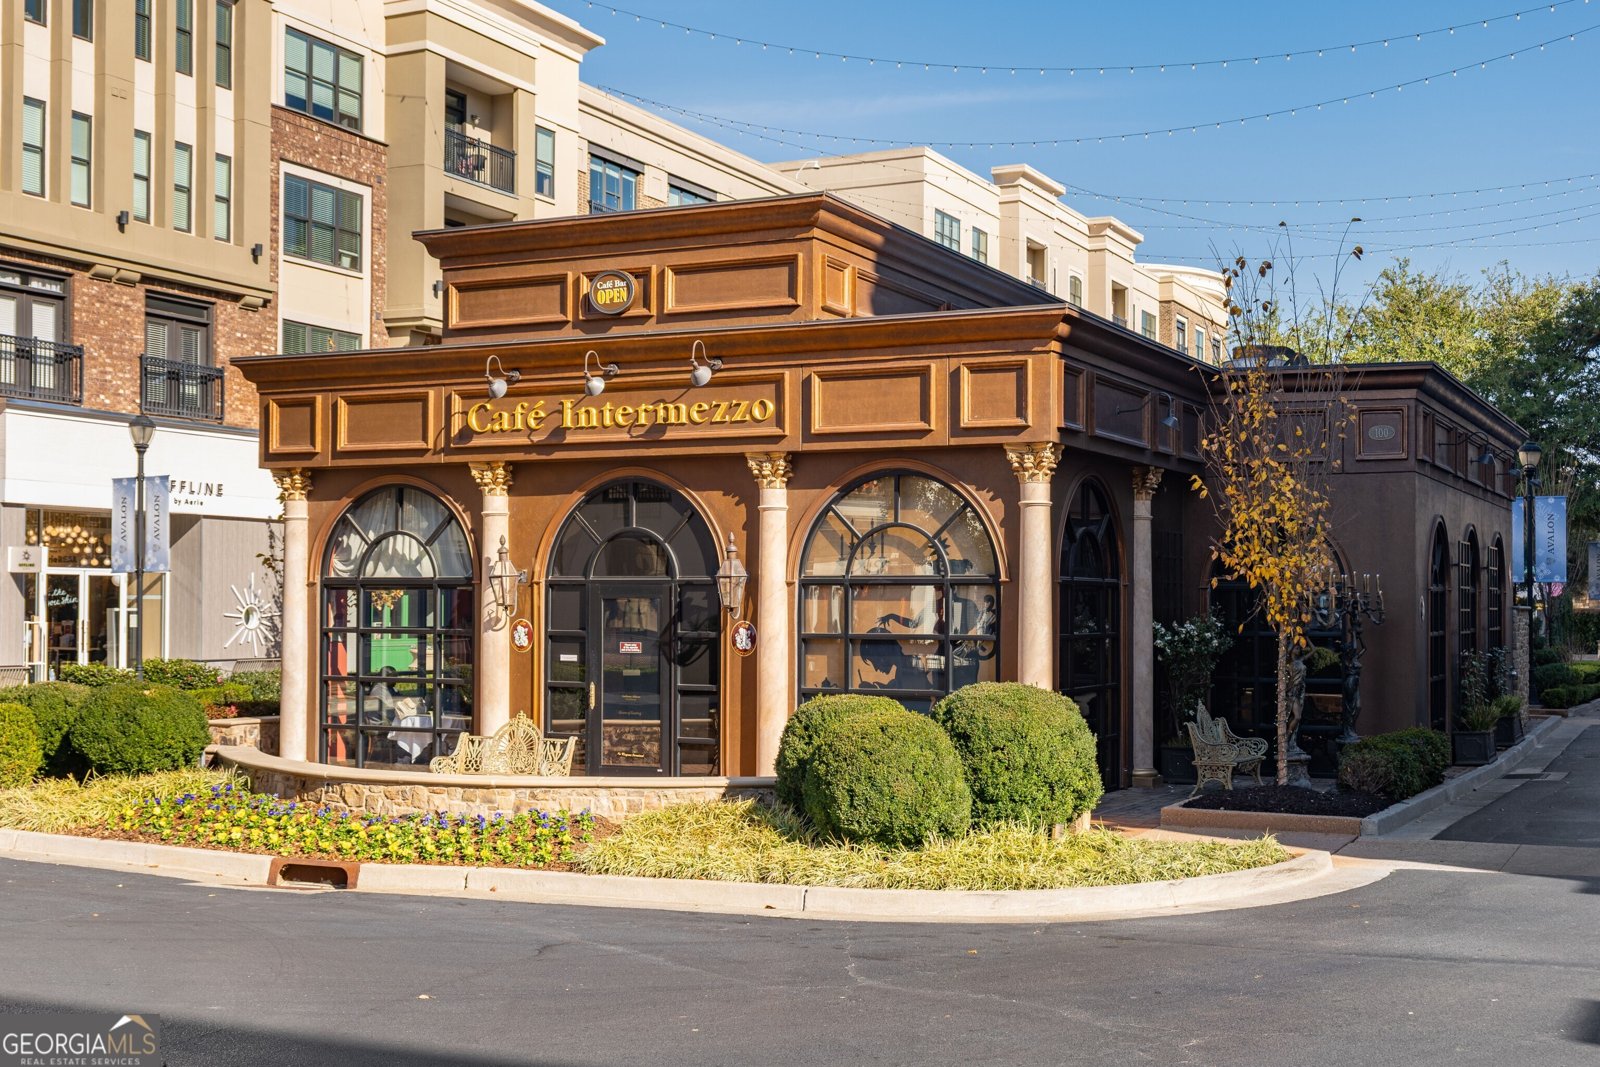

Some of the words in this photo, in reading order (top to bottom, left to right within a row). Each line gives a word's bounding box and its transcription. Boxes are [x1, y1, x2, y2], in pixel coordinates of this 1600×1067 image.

[597, 281, 613, 289] Café
[615, 279, 627, 287] Bar
[597, 287, 627, 304] OPEN
[466, 400, 545, 433] Café
[561, 397, 775, 430] Intermezzo
[1375, 428, 1388, 438] 100
[169, 479, 224, 497] FFLINE
[174, 498, 182, 506] by
[185, 498, 204, 506] Aerie
[120, 496, 128, 542] AVALON
[153, 494, 161, 541] AVALON
[1547, 512, 1555, 555] AVALON
